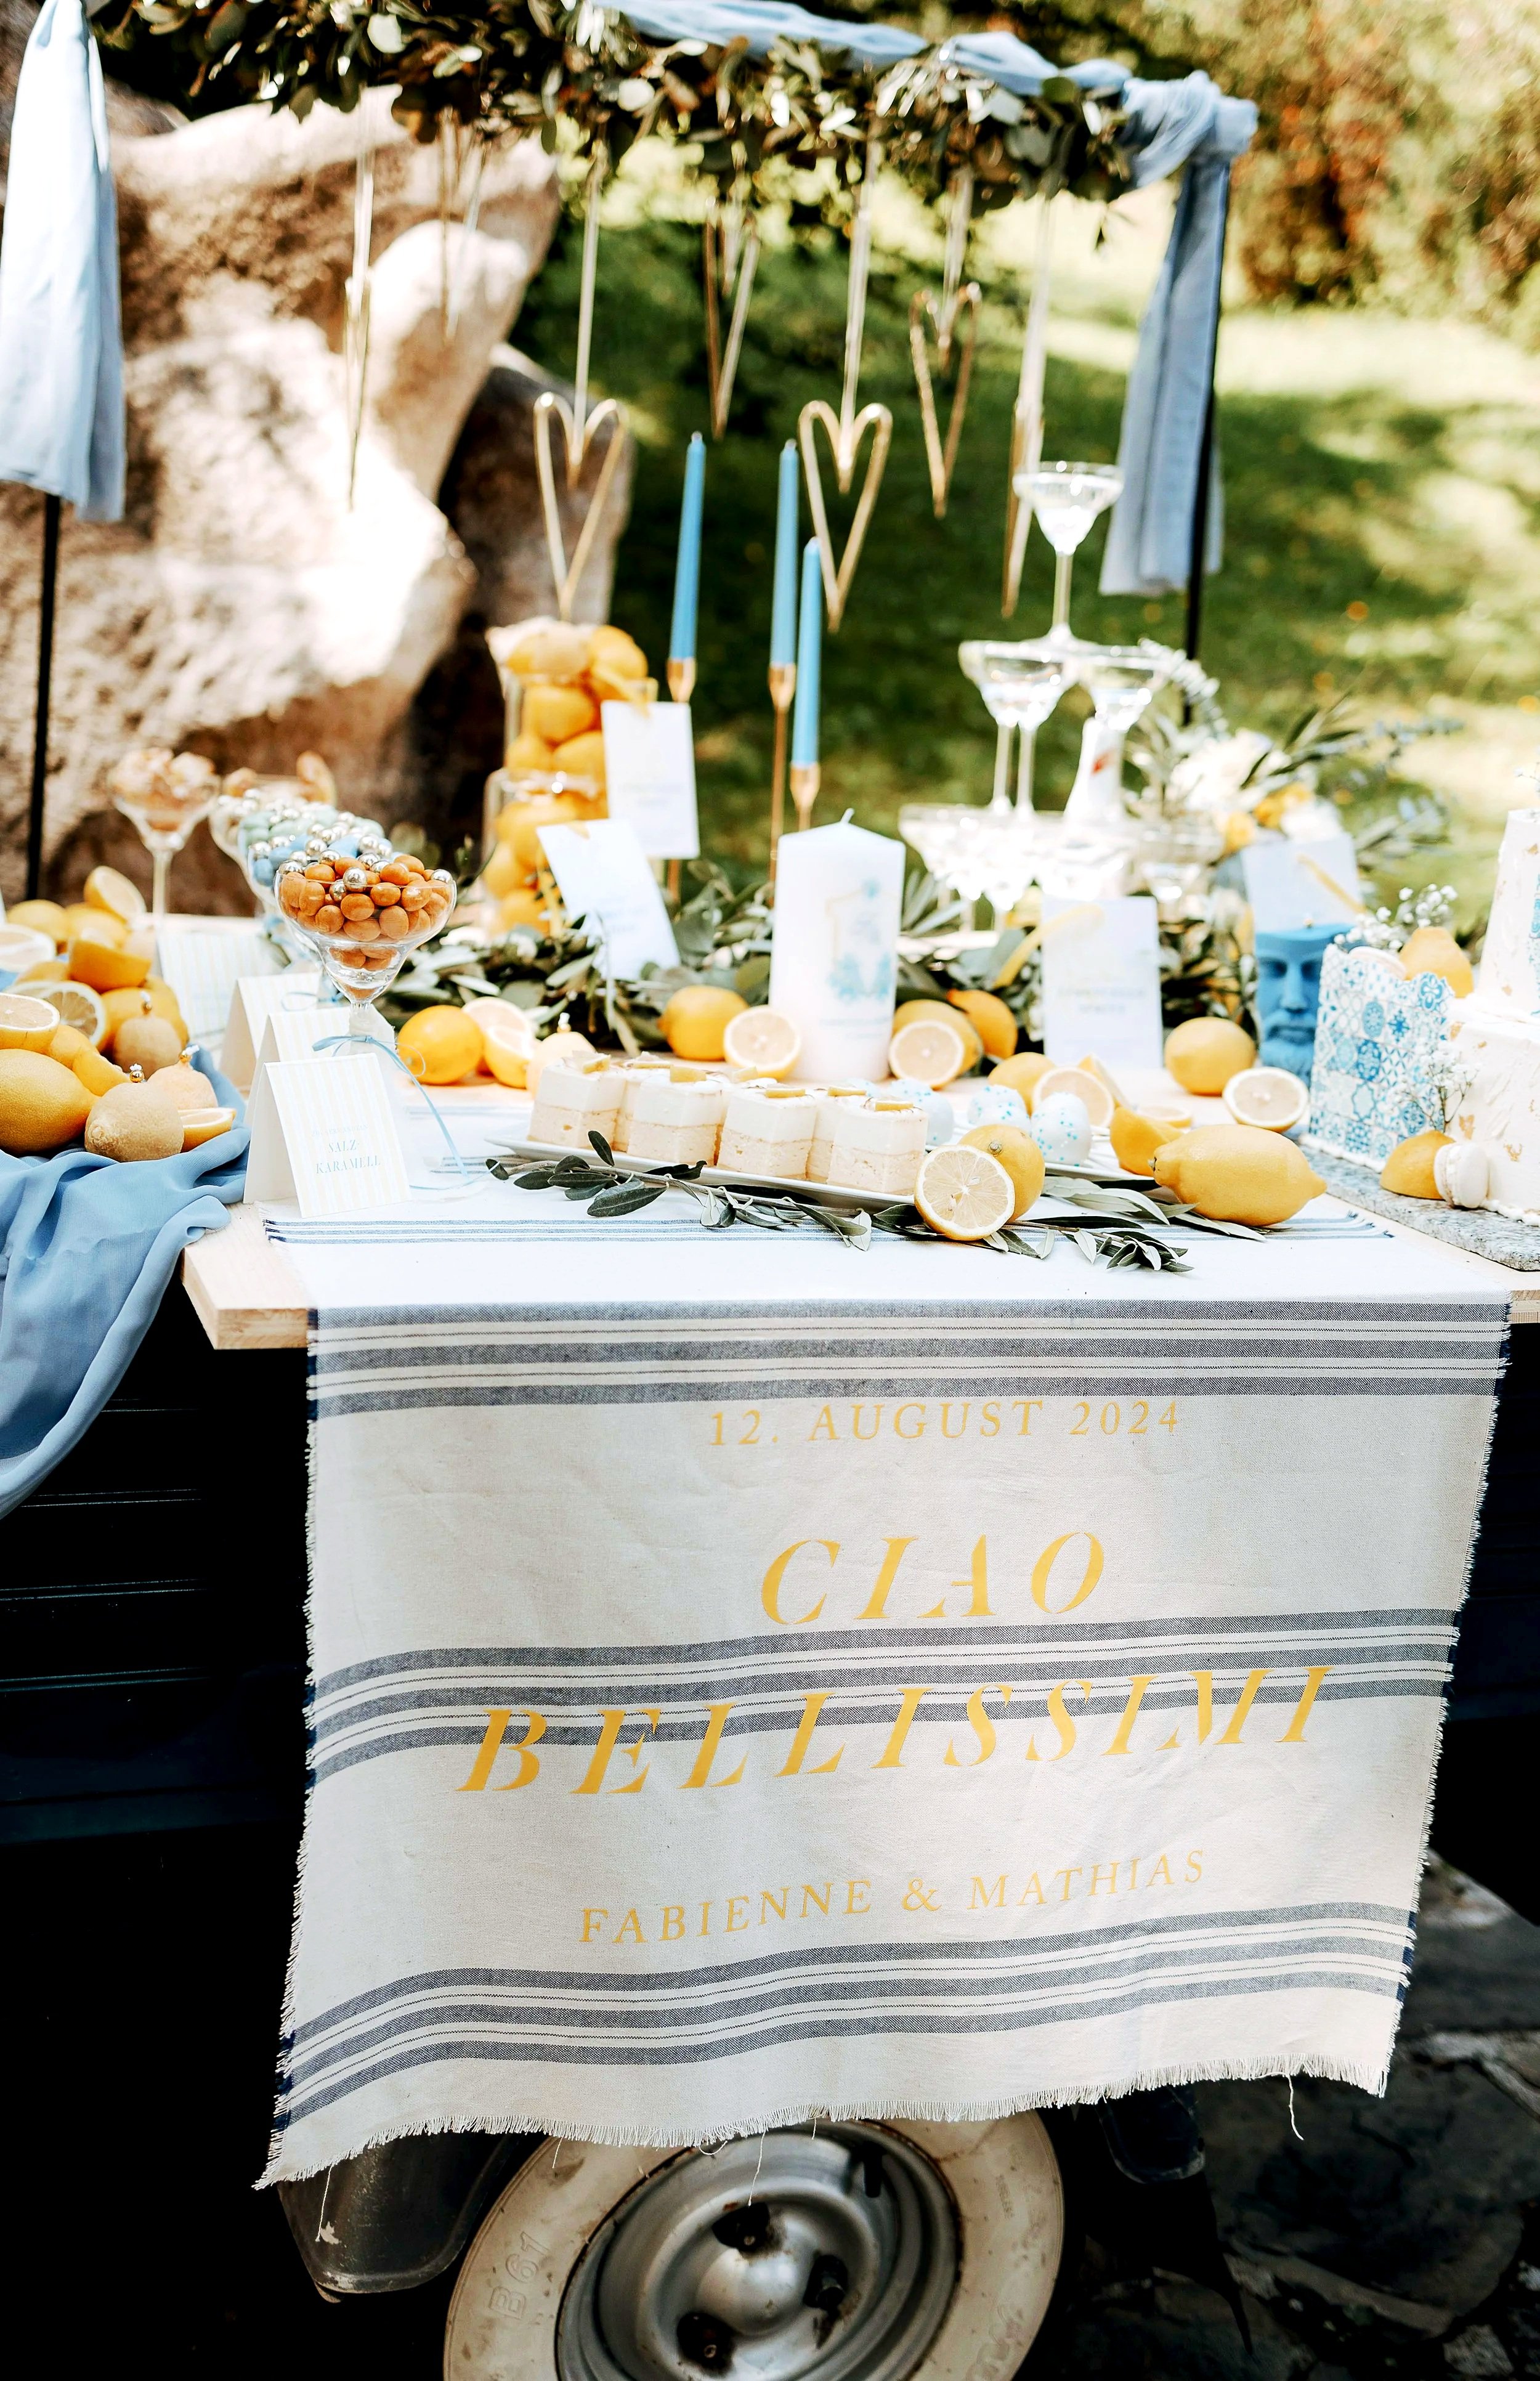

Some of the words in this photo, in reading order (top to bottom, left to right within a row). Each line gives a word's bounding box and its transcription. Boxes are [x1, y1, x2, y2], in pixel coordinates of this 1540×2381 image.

[315, 1155, 381, 1174] KARAMELL
[710, 1410, 779, 1446] 12.
[807, 1399, 1045, 1441] AUGUST
[1069, 1400, 1180, 1435] 2024
[760, 1531, 1105, 1625] CIAO
[455, 1665, 1334, 1795] BELLISSIMI
[578, 1880, 872, 1944] FABIENNE
[901, 1878, 941, 1912] &
[967, 1849, 1206, 1910] MATHIAS
